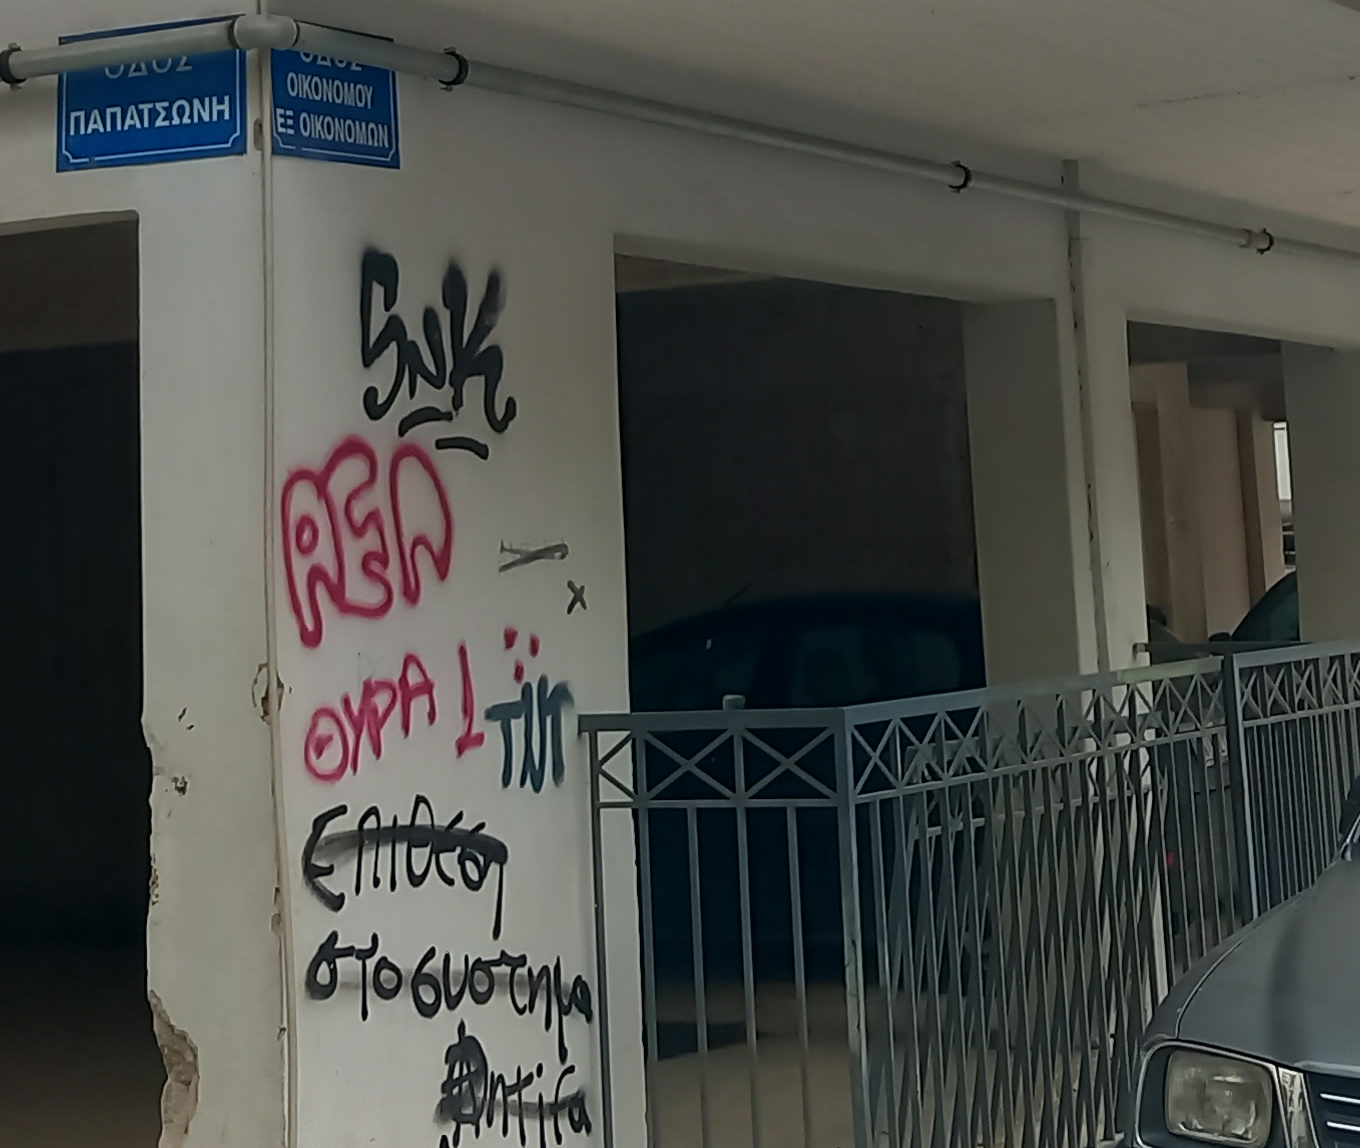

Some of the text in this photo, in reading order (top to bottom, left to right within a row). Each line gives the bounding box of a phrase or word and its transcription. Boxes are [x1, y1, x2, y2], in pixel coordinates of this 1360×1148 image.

[286, 71, 374, 109] ΟΙΚΟΝΟΜΟΥ
[69, 95, 231, 136] ΠΑΠΑΤΣΩΝΗ
[276, 107, 390, 149] ΕΞ ΟΙΚΟΝΟΜΩΝ
